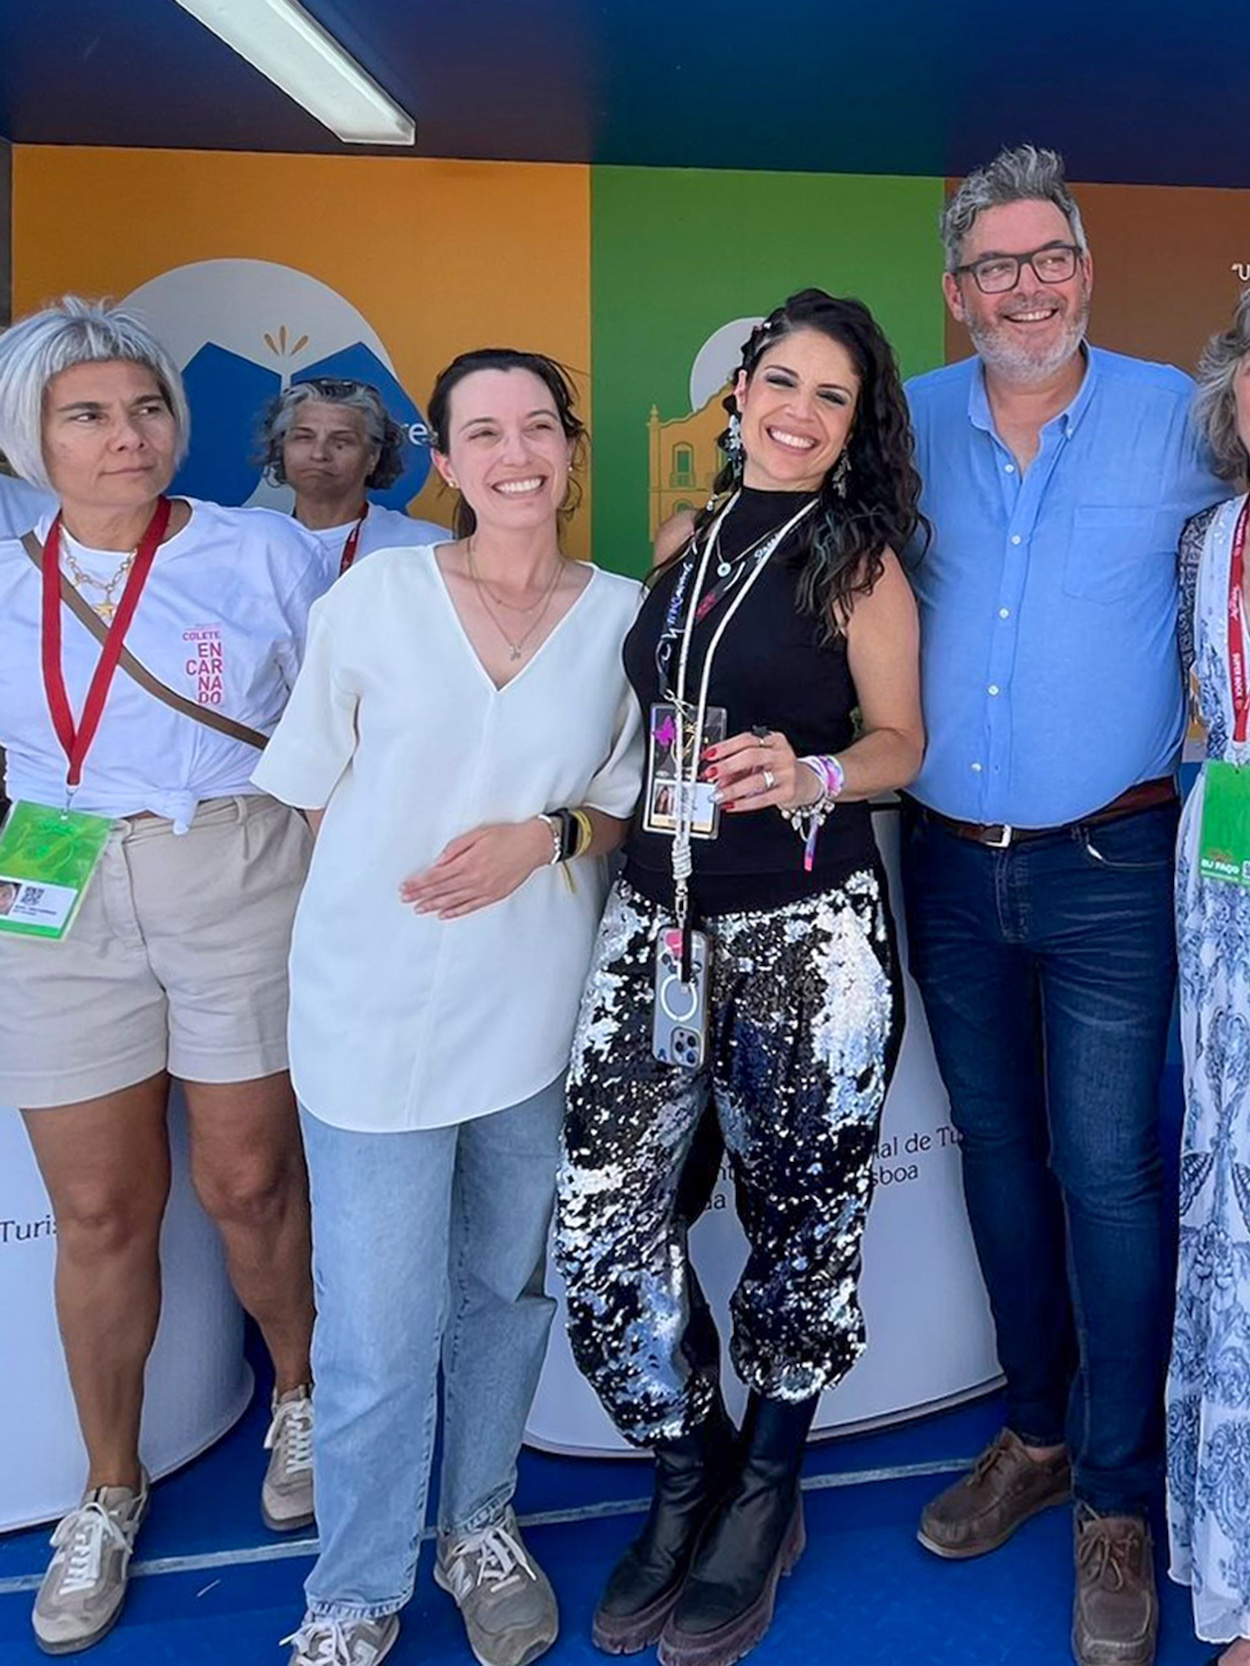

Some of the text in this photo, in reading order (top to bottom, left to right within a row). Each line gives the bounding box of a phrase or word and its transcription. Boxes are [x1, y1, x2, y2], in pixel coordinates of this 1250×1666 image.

[198, 642, 222, 658] EN
[186, 658, 223, 676] CAR
[198, 675, 223, 692] NA
[198, 690, 222, 705] DO
[876, 1136, 898, 1159] al
[904, 1132, 931, 1154] de
